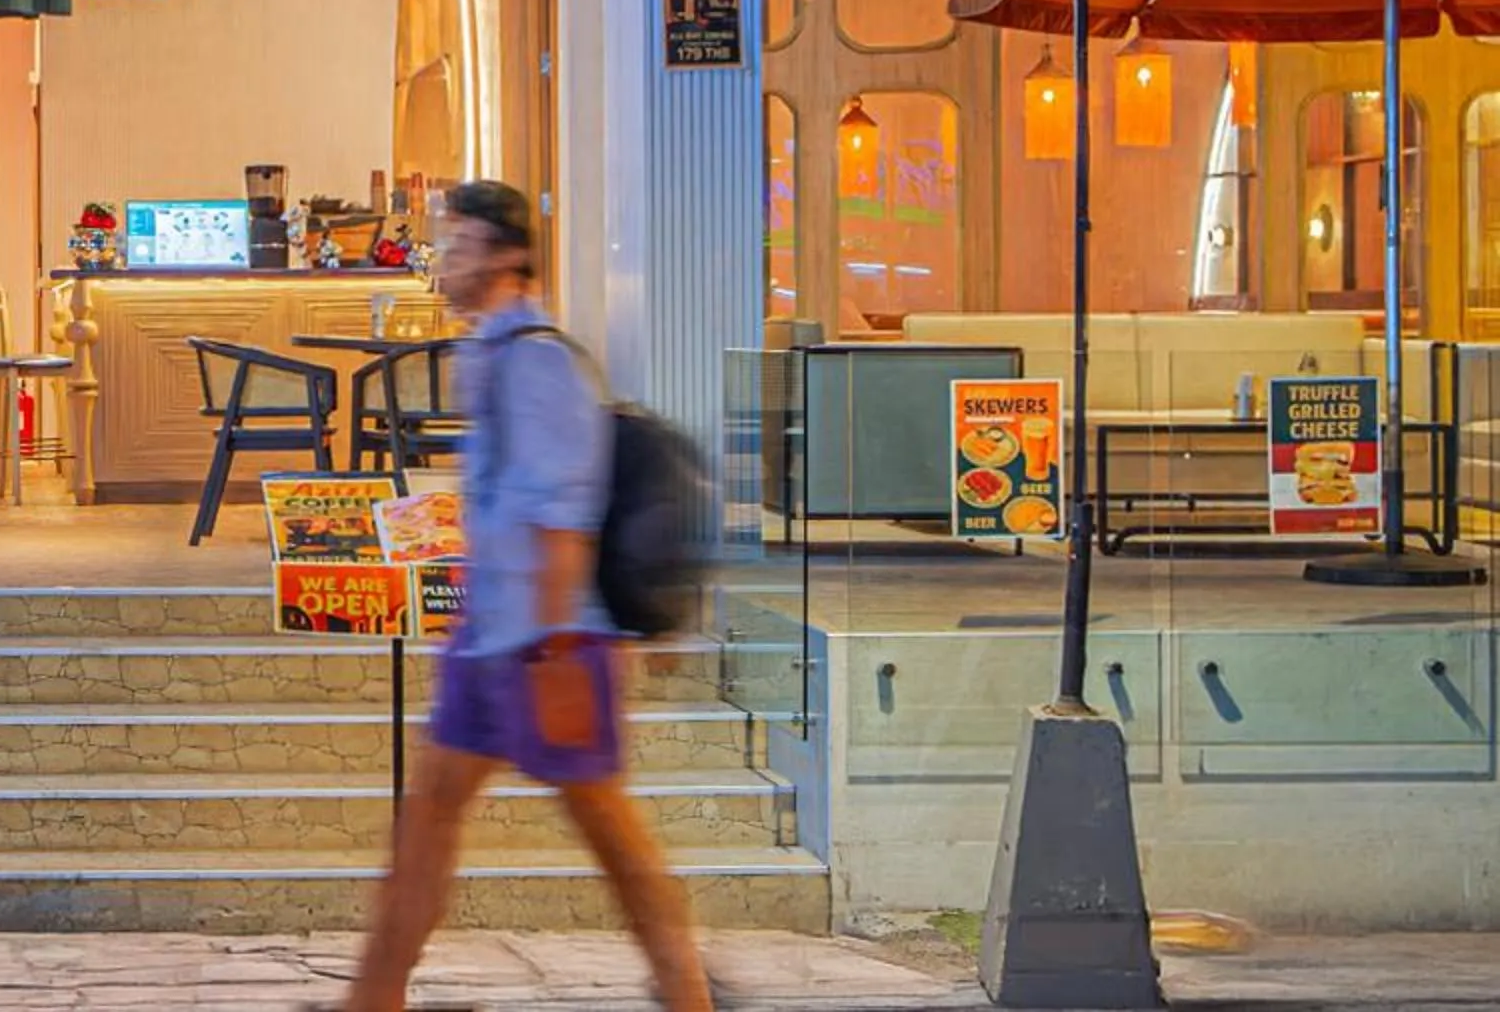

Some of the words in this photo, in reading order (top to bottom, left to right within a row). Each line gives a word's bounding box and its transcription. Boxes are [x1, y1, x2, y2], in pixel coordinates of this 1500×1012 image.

[1288, 385, 1360, 401] TRUFFLE
[964, 398, 1049, 416] SKEWERS
[1288, 403, 1362, 420] GRILLED
[1289, 421, 1360, 438] CHEESE
[299, 575, 336, 592] WE
[344, 577, 389, 594] ARE
[298, 593, 389, 618] OPEN
